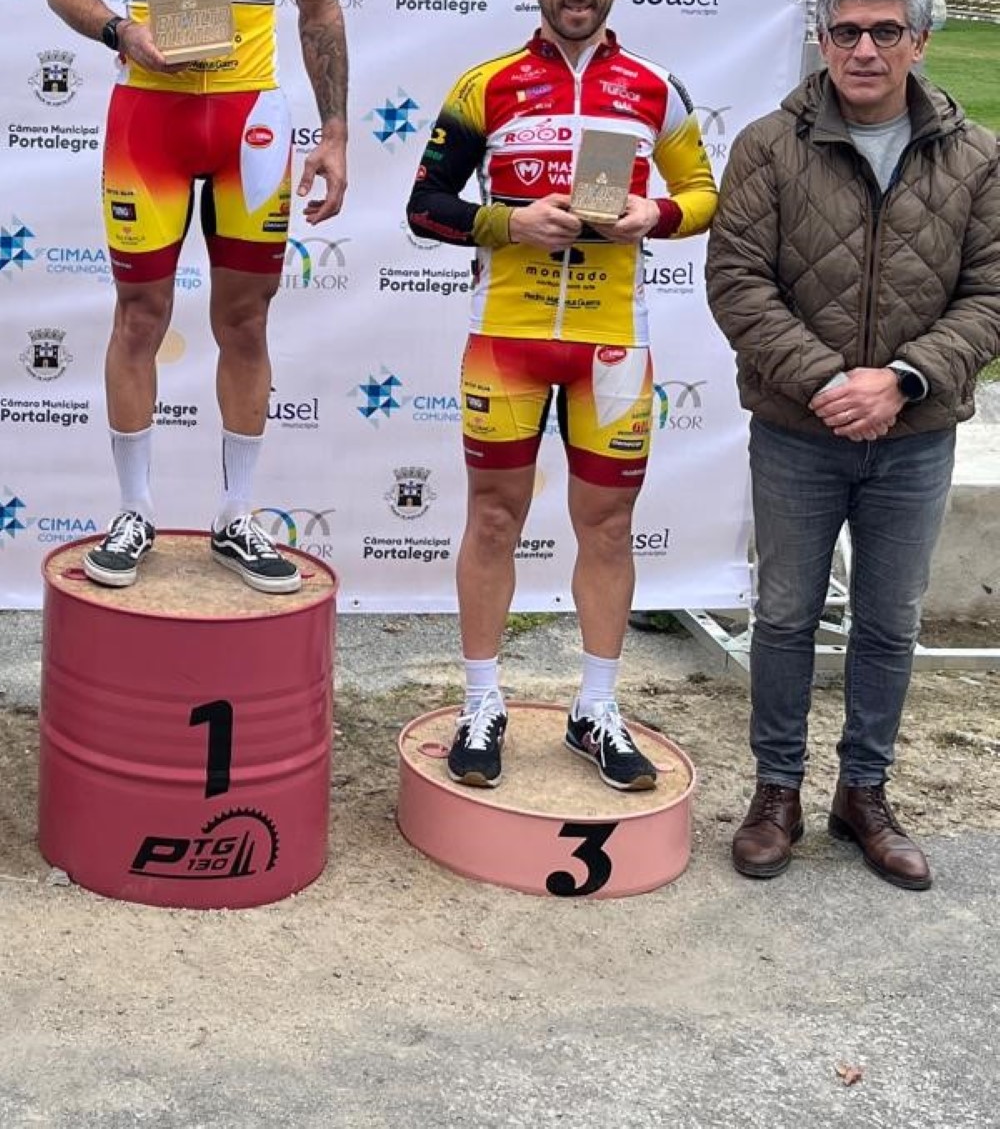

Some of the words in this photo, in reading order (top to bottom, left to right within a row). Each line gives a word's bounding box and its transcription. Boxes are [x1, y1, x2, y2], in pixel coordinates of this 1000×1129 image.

[8, 124, 48, 134] Câmara
[51, 125, 99, 135] Municipal
[9, 134, 99, 152] Portalegre
[47, 248, 107, 262] CIMAA
[379, 268, 420, 277] Câmara
[423, 269, 470, 279] Municipal
[643, 262, 693, 285] usel
[379, 278, 469, 296] Portalegre
[0, 398, 40, 408] Câmara
[42, 399, 89, 411] Municipal
[267, 398, 319, 421] usel
[0, 409, 89, 426] Portalegre
[38, 518, 96, 532] CIMAA
[364, 536, 402, 545] Câmara
[405, 537, 450, 547] Municipal
[364, 546, 449, 562] Portalegre
[190, 700, 234, 798] 1
[546, 822, 619, 897] 3
